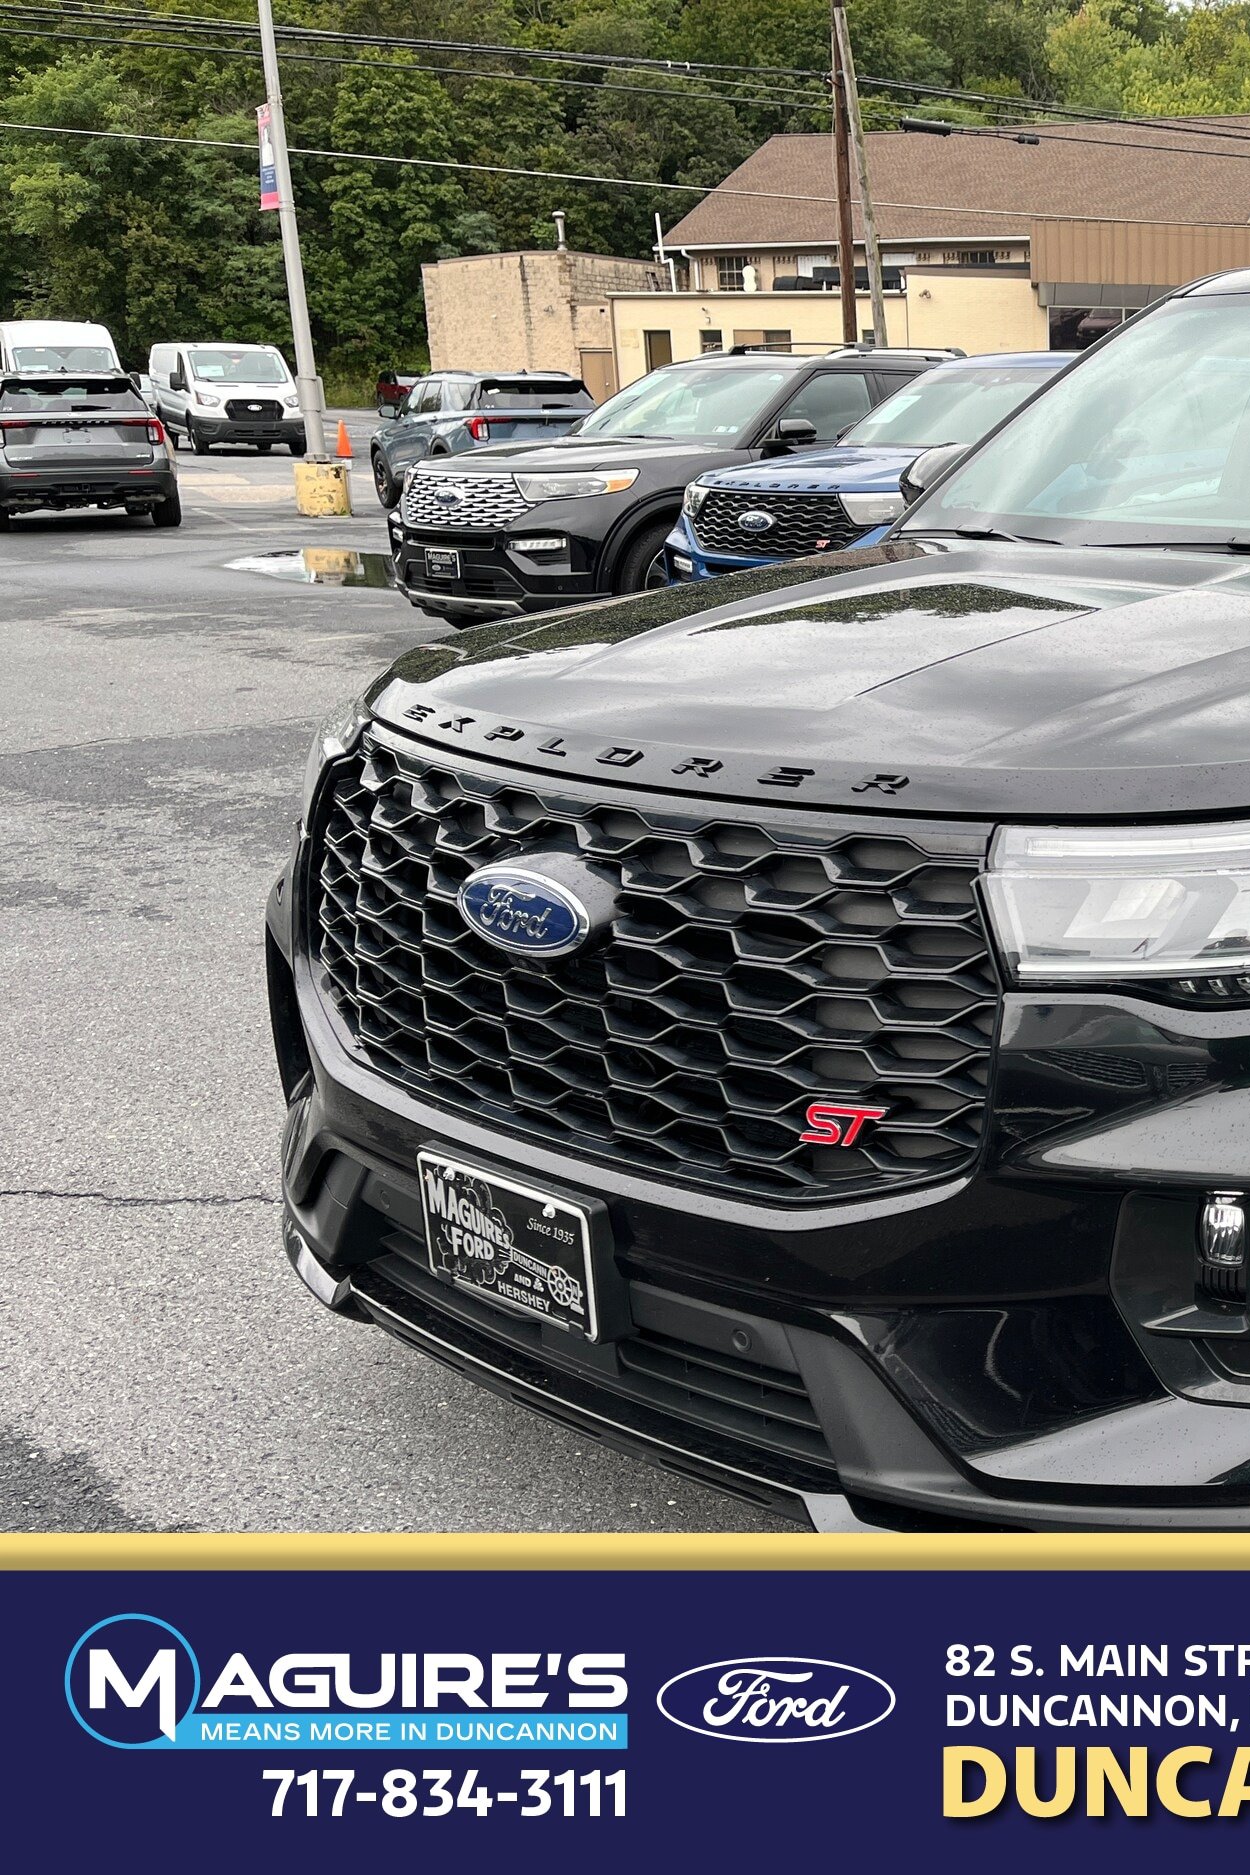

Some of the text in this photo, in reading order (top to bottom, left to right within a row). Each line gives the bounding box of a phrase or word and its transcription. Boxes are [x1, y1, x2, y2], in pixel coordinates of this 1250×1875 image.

[713, 480, 841, 490] EXPLORER
[815, 539, 831, 549] ST
[403, 703, 911, 795] EXPLORER
[479, 883, 553, 939] Ford
[799, 1101, 890, 1147] ST
[450, 1226, 495, 1262] FORD
[526, 1217, 575, 1246] Since 1935
[497, 1280, 551, 1313] HERSHEY
[513, 1273, 531, 1288] AND
